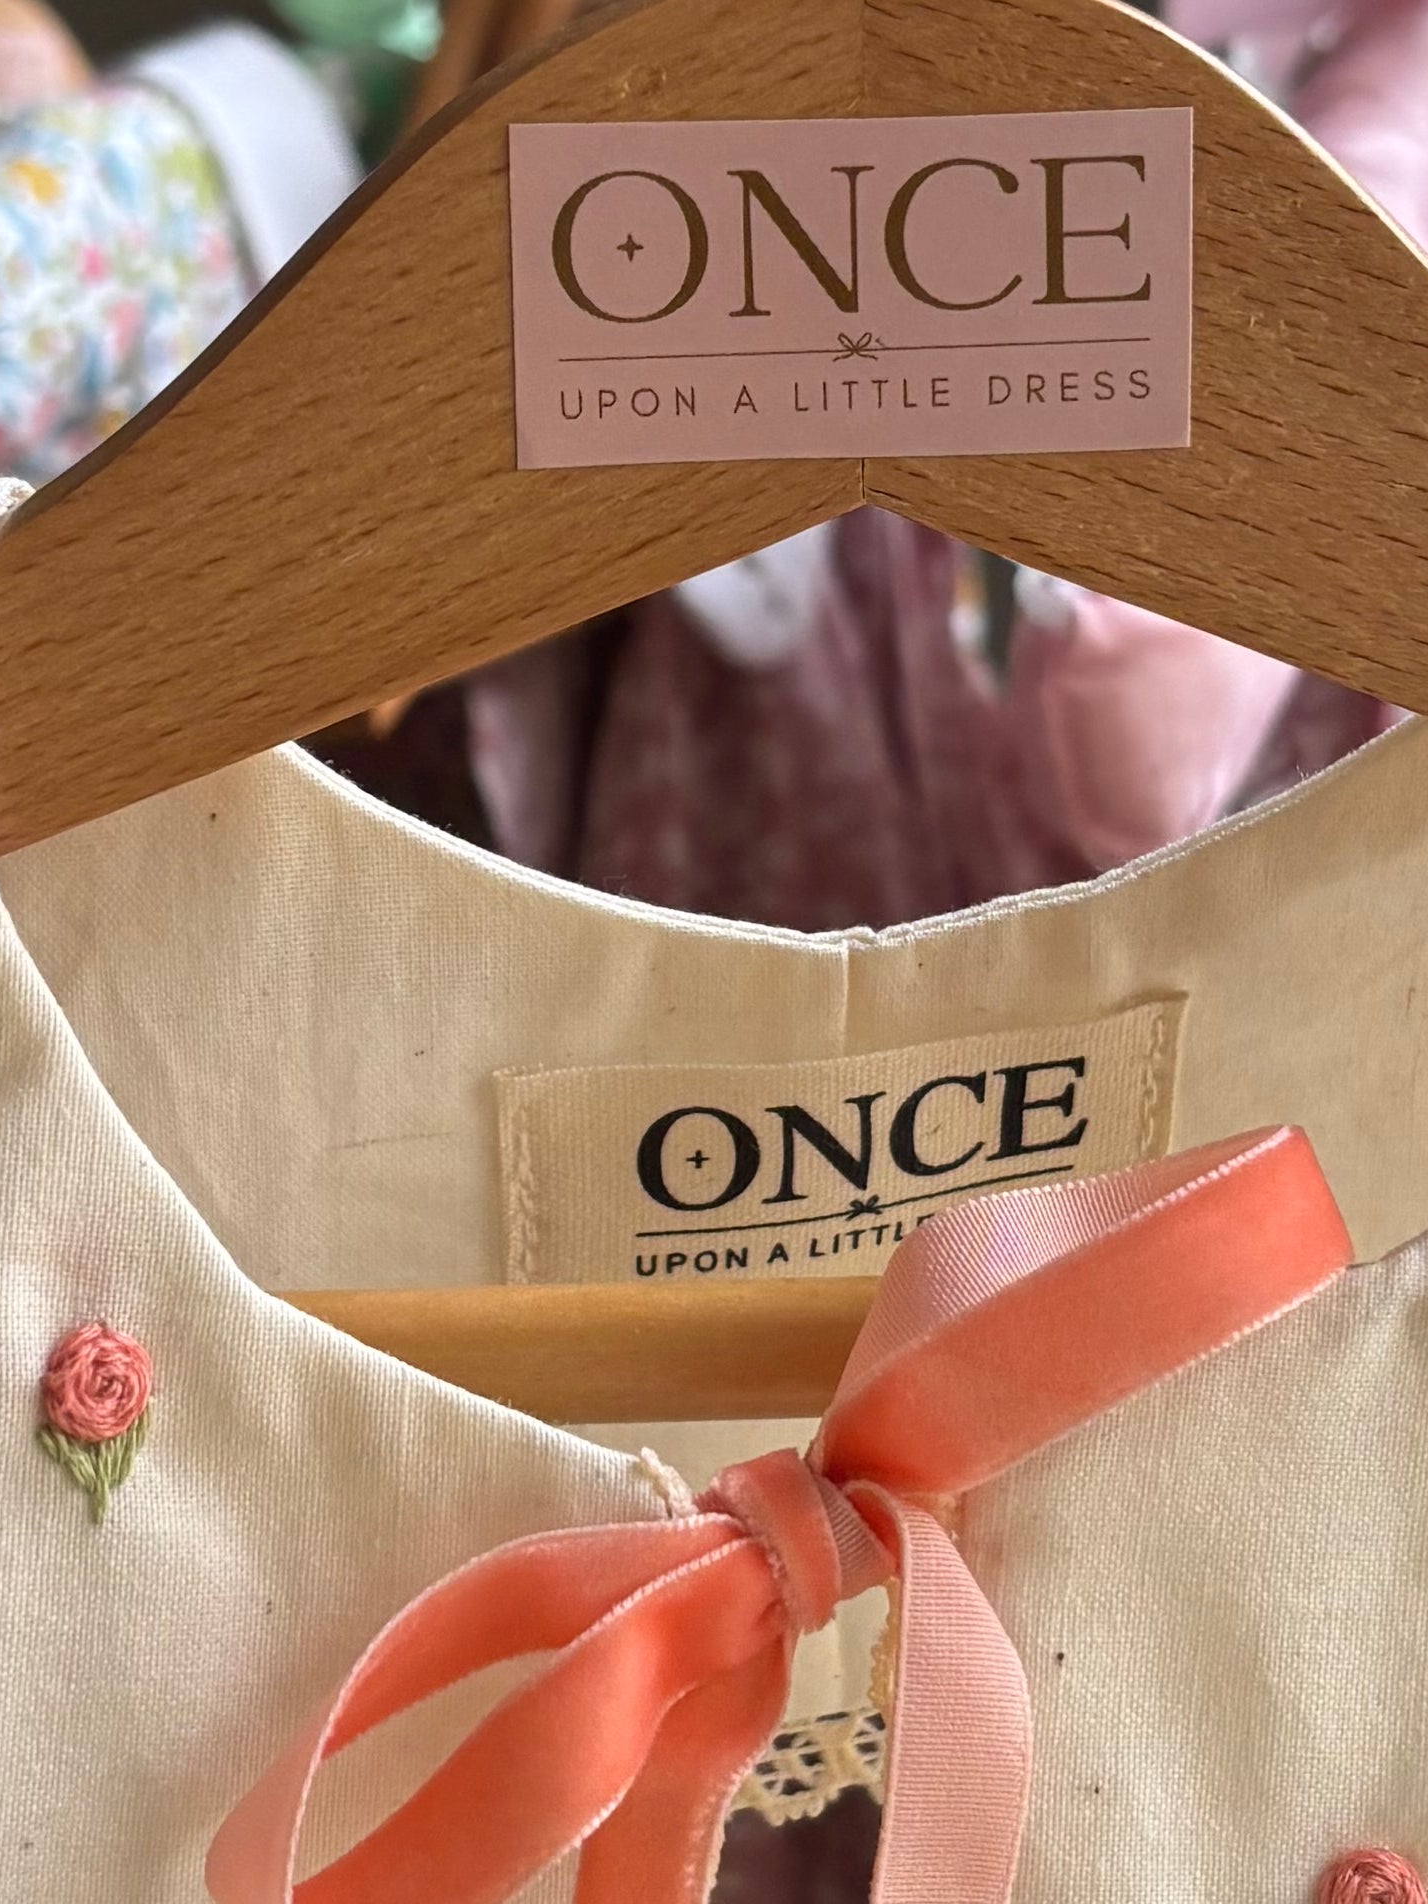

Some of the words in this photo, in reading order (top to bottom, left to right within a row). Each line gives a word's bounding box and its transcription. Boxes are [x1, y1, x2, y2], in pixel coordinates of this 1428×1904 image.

[552, 154, 1152, 324] ONCE
[559, 385, 698, 421] UPON
[733, 384, 760, 415] A
[793, 377, 952, 412] LITTLE
[988, 369, 1152, 405] DRESS
[636, 1055, 1089, 1212] ONCE
[635, 1247, 749, 1277] UPON
[766, 1242, 790, 1265] A
